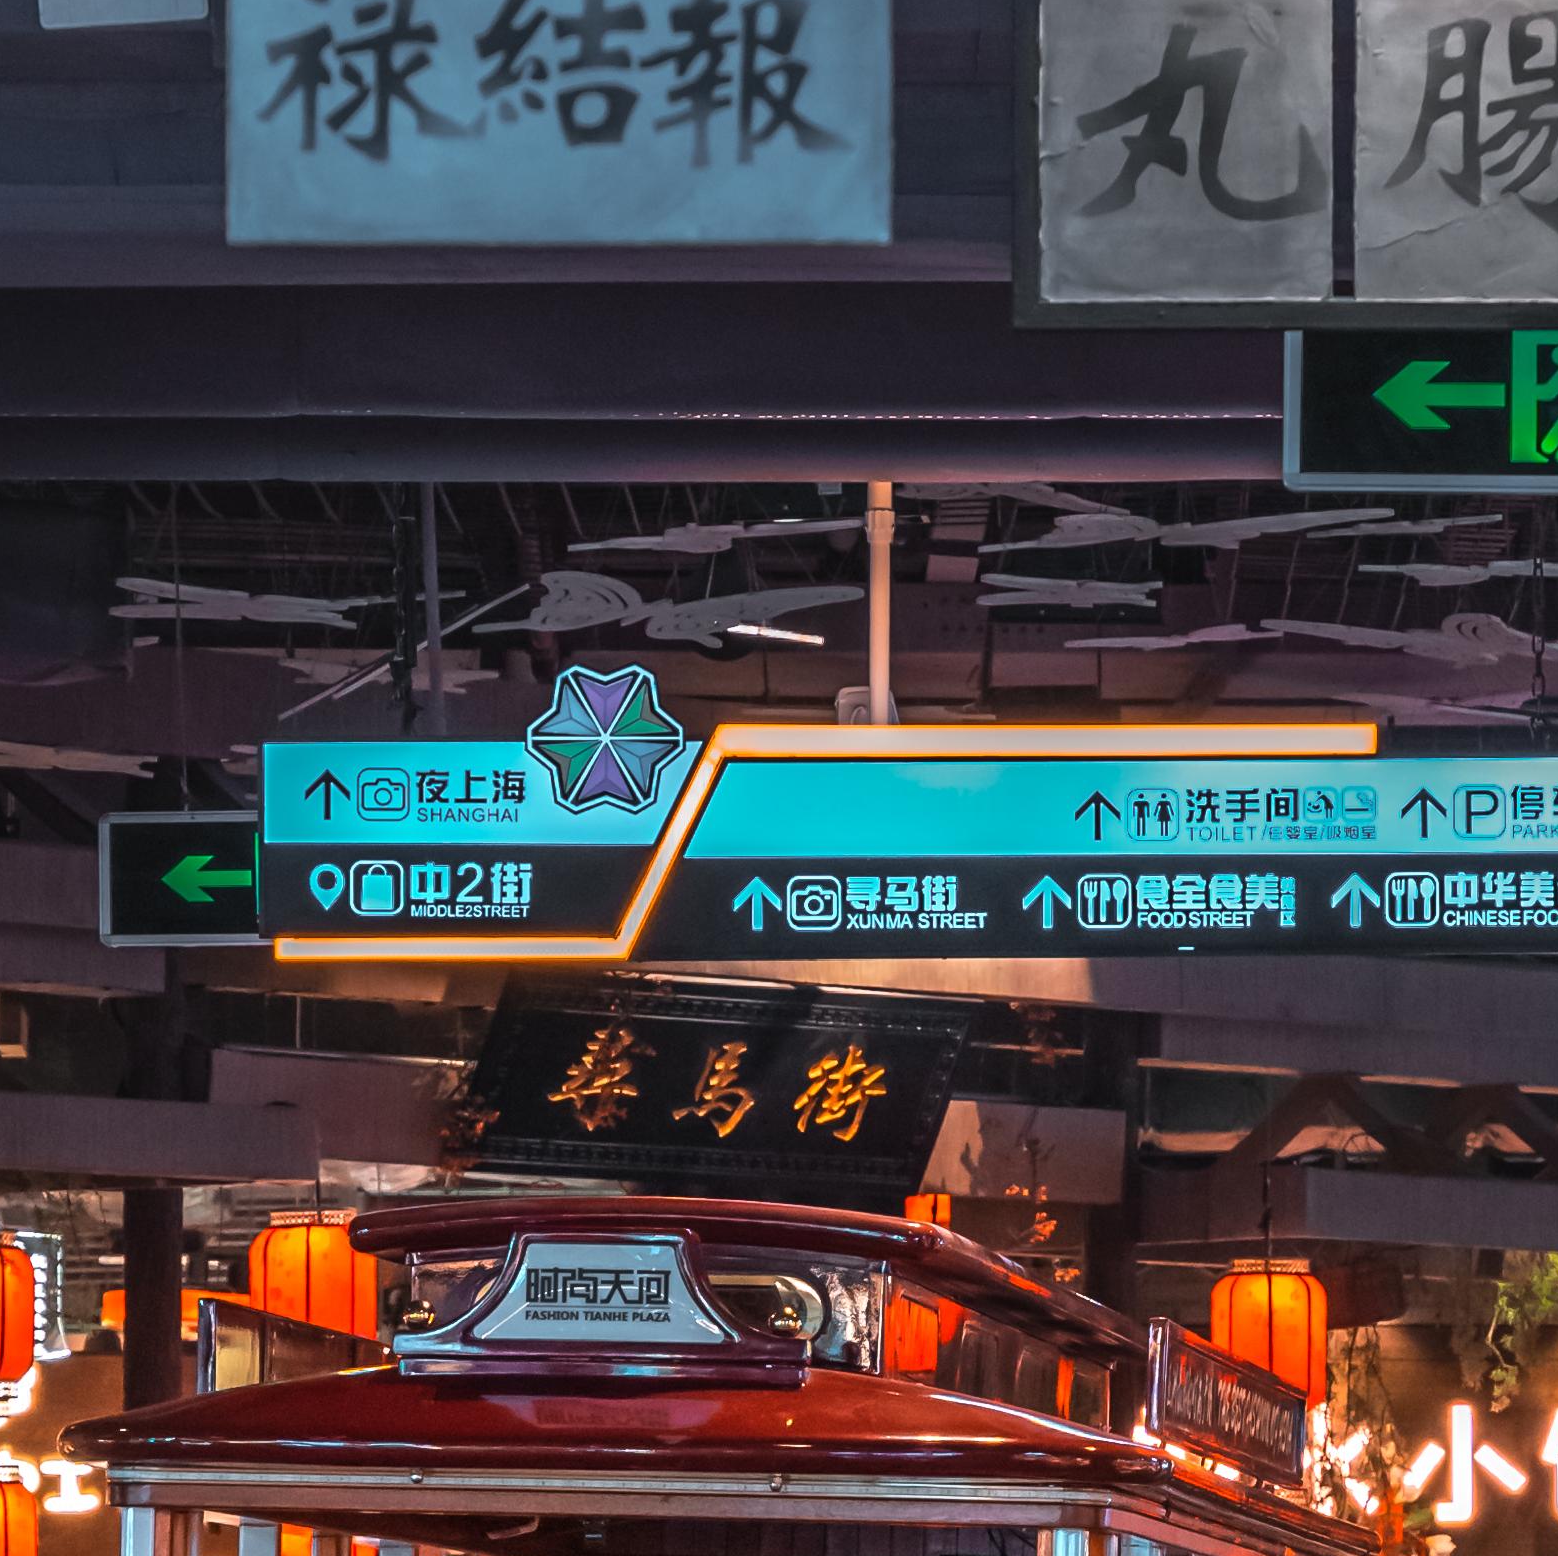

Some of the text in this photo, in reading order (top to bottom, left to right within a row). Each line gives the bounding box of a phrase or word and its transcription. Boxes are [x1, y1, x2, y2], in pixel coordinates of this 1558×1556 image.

[416, 769, 526, 804] 夜上海
[1186, 788, 1300, 823] 洗手间
[417, 807, 519, 823] SHANGHAI
[1187, 826, 1256, 841] TOILET
[410, 861, 533, 904] 中2街
[846, 875, 957, 911] 寻马街
[1136, 873, 1280, 910] 食全食美
[411, 905, 530, 918] MIDDLE2STREET
[1137, 911, 1254, 928] FOOD STREET
[1443, 910, 1521, 926] CHINESE
[846, 913, 987, 929] XUNMA STREET
[525, 1310, 671, 1323] FASHION TIANHE PLAZA
